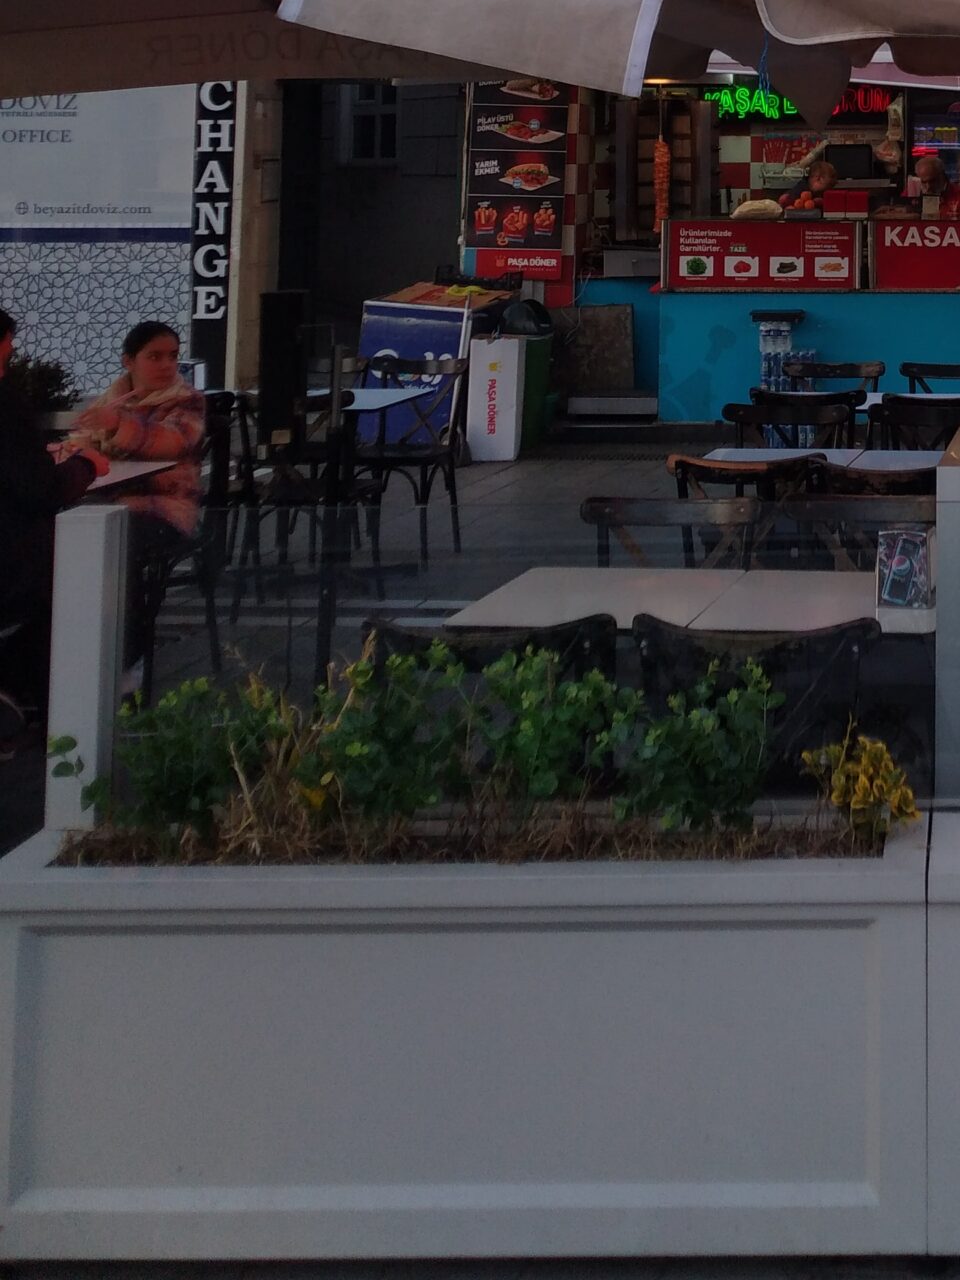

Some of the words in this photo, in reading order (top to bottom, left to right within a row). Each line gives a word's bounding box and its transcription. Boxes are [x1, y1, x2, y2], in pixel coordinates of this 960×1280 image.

[2, 129, 72, 143] OFFICE
[192, 81, 233, 319] CHANGE
[33, 203, 152, 217] beyazitdoviz.com
[507, 257, 528, 268] PAŞA
[529, 256, 558, 267] DÖNER
[485, 378, 497, 403] PAŞA
[487, 404, 498, 436] DÖNER
